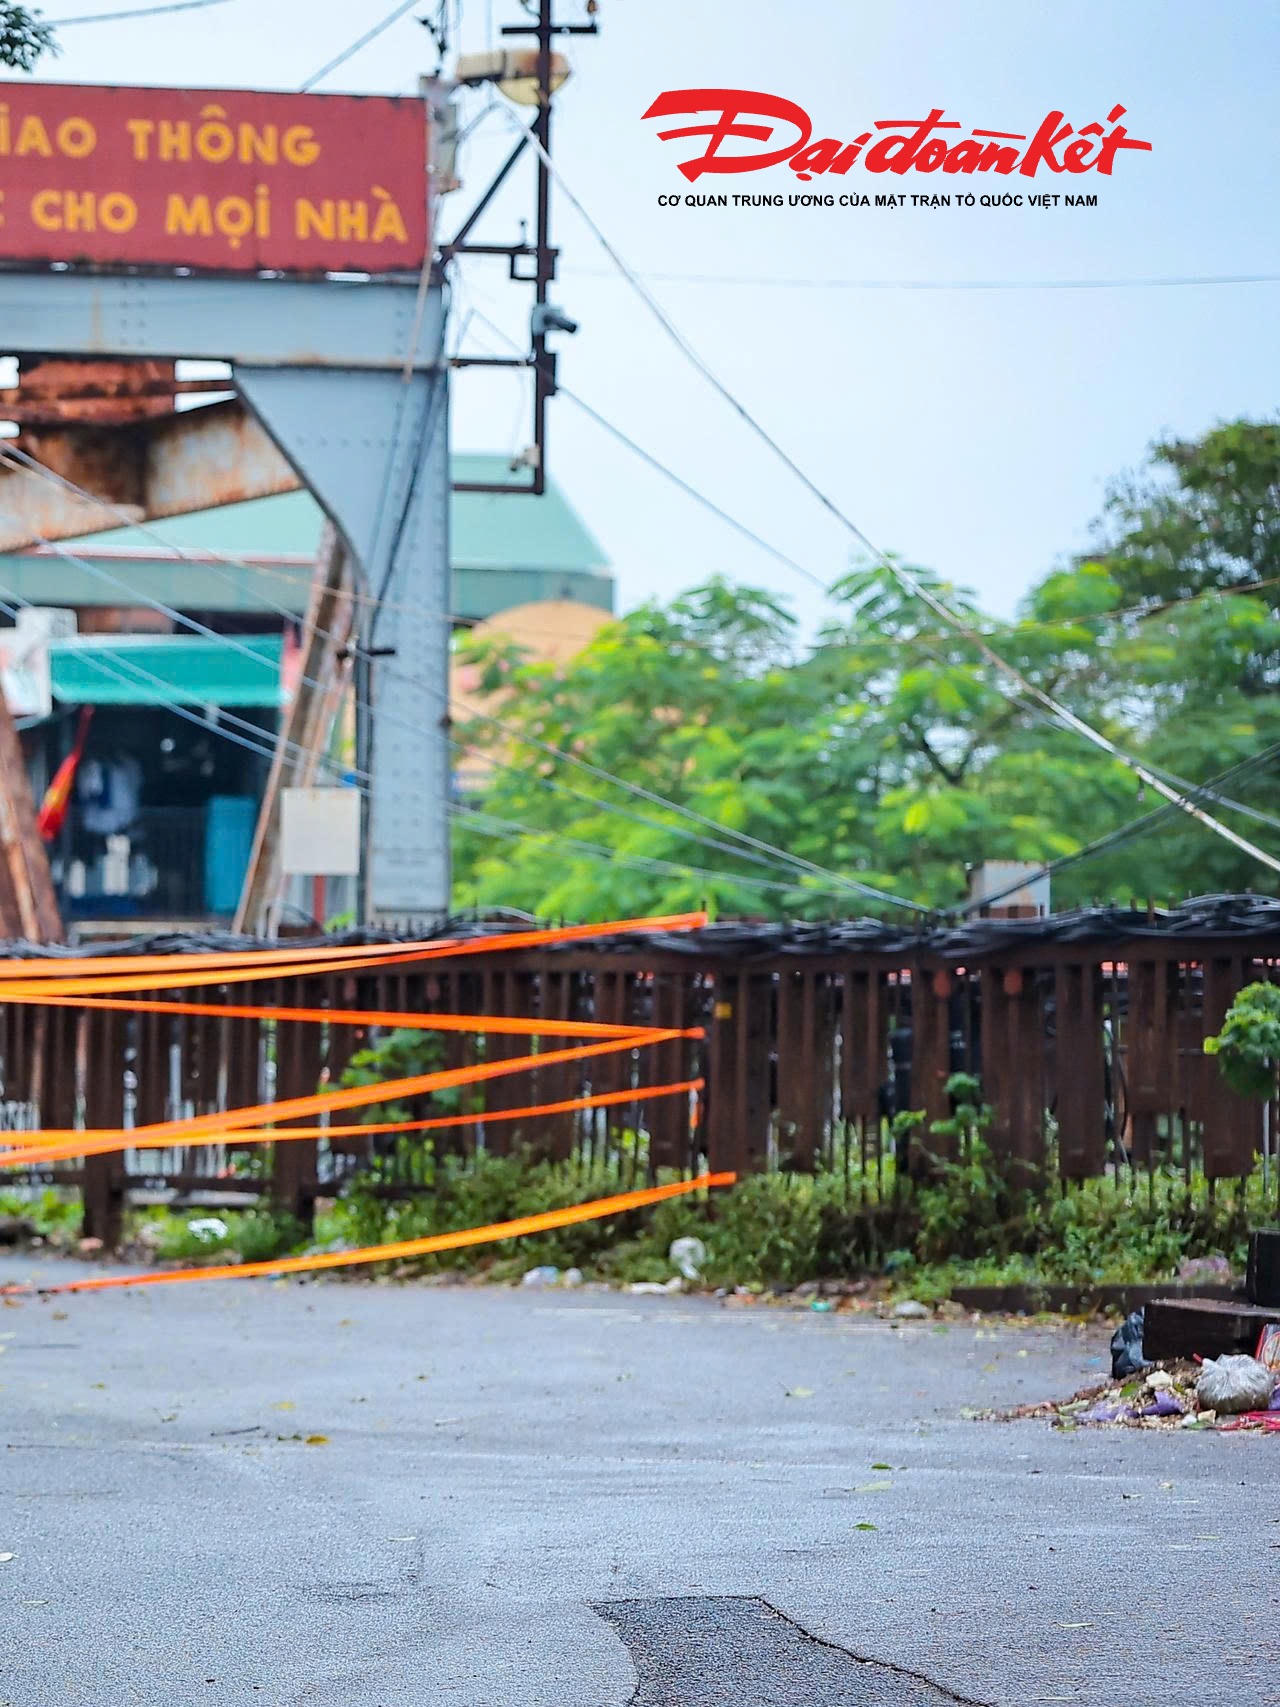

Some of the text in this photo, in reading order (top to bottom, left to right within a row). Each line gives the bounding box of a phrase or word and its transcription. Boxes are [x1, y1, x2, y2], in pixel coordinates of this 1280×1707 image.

[125, 103, 322, 167] THÔNG
[30, 189, 138, 234] CHO
[294, 184, 409, 245] NHÀ
